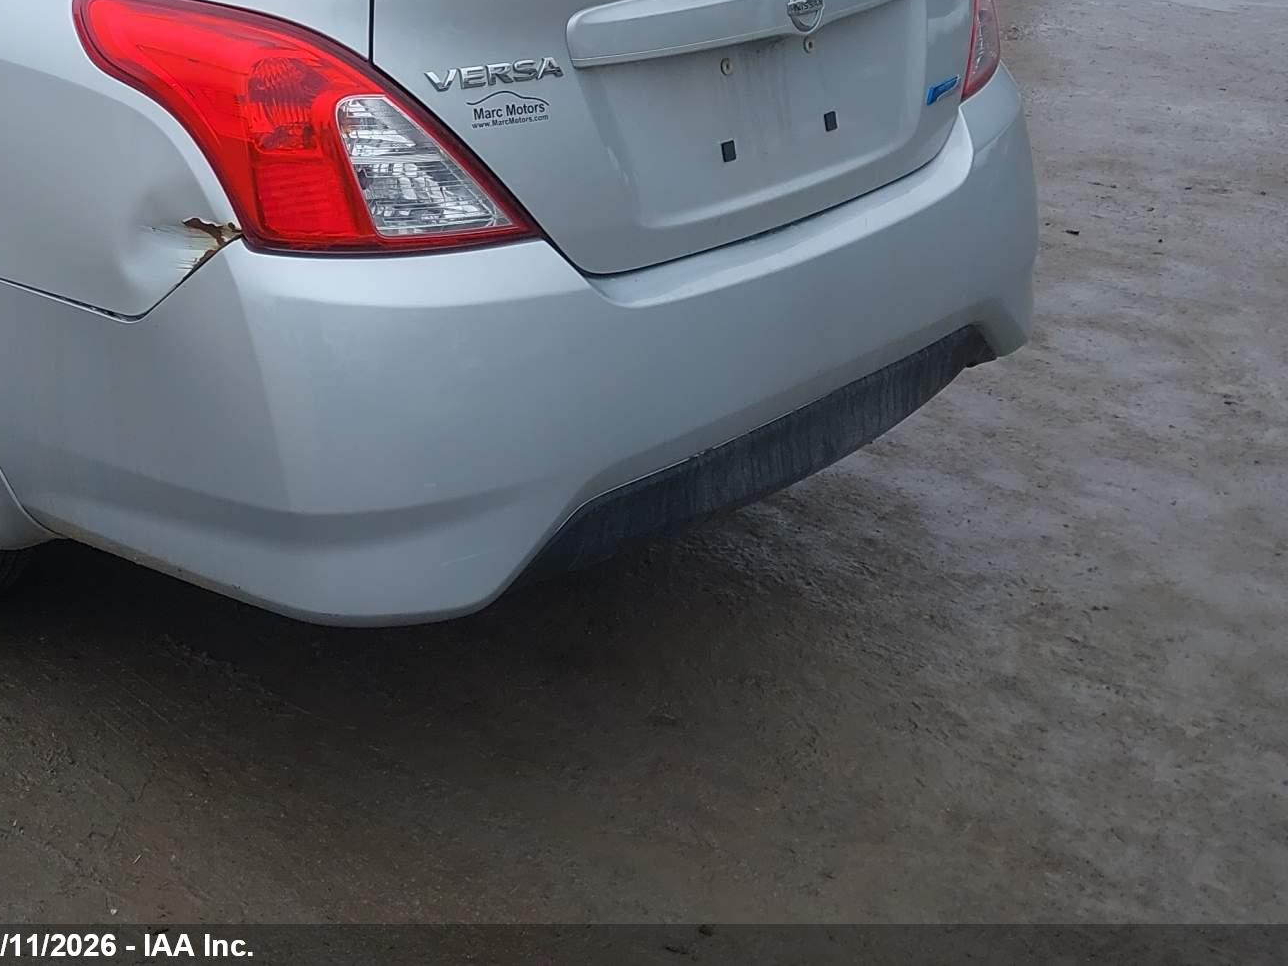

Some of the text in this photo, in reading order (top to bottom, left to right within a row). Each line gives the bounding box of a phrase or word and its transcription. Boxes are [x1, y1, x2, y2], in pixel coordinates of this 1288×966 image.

[424, 56, 564, 92] VERSA
[473, 103, 545, 120] Marc Motors
[472, 114, 549, 129] www.MarcMotors.com
